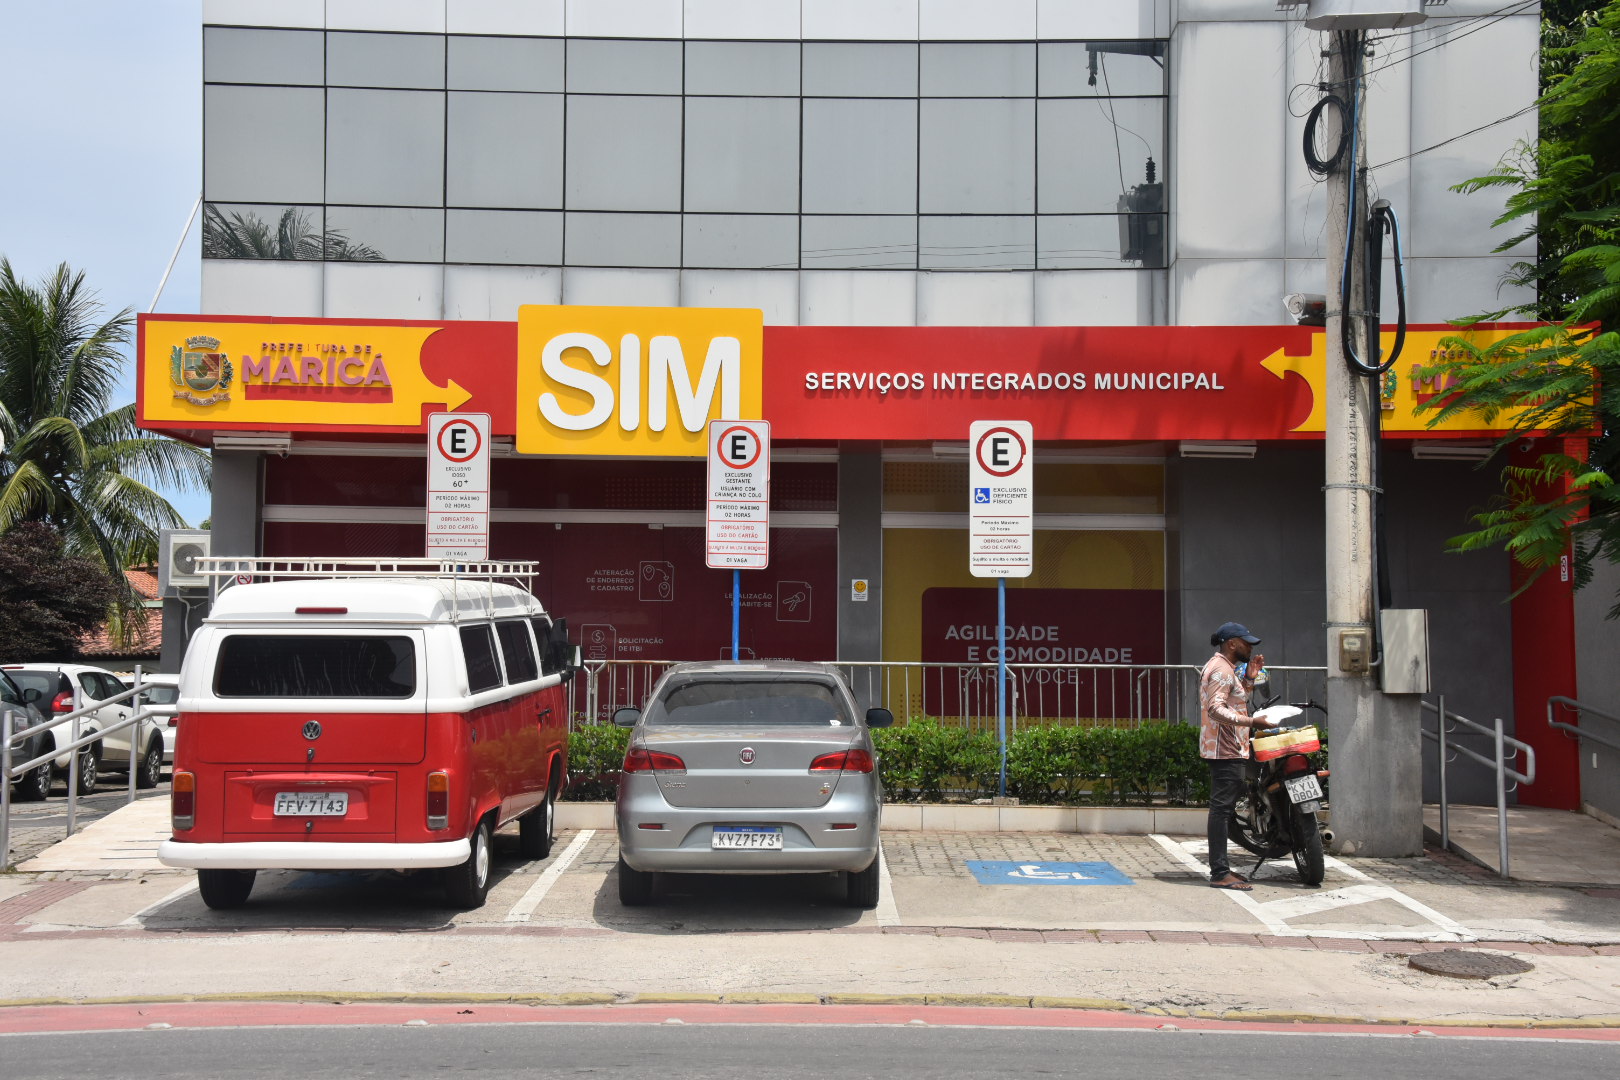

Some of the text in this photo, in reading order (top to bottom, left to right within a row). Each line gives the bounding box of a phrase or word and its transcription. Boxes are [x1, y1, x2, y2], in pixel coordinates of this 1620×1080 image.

[262, 342, 372, 353] PREFEITURA DE
[242, 353, 392, 386] MARICÁ
[538, 332, 741, 433] SIM
[805, 372, 1225, 394] SERVIÇOS INTEGRADOS MUNICIPAL
[451, 429, 466, 453] E
[732, 436, 747, 460] E
[992, 438, 1010, 466] E
[945, 625, 1058, 641] AGILIDADE
[968, 646, 1132, 663] E COMODIDADE
[1291, 781, 1315, 793] KYU
